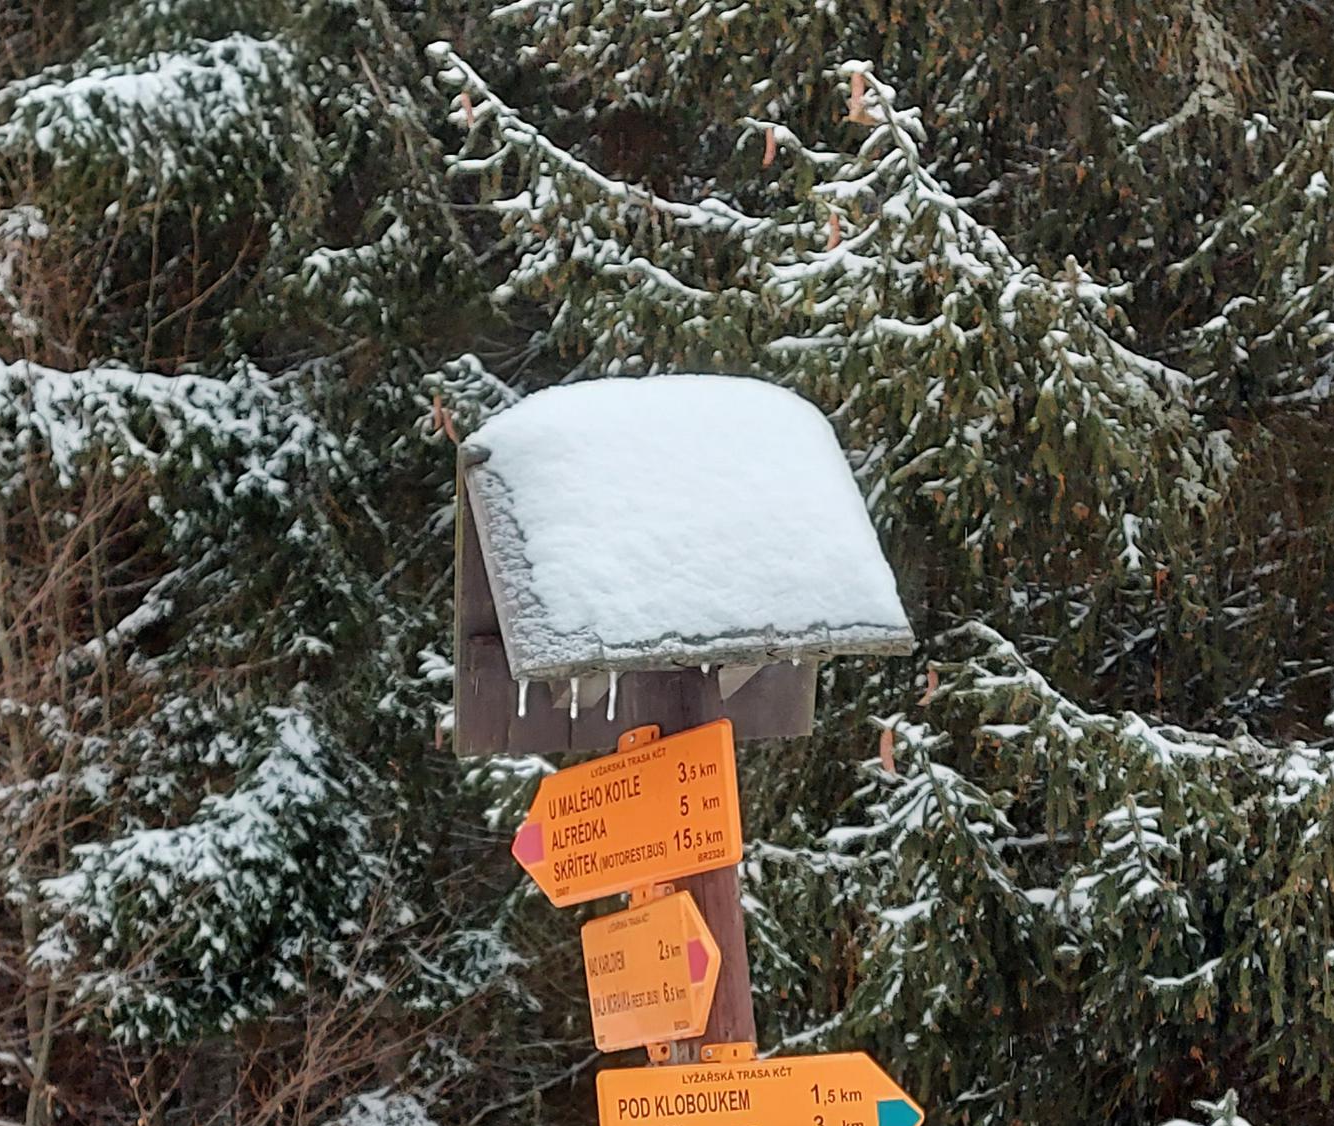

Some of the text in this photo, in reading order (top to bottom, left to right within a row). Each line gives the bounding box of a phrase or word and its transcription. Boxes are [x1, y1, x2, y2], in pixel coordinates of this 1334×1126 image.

[548, 775, 641, 820] U MALÉHO KOTLE
[551, 795, 720, 851] ALFRÉDKA 5 km
[553, 829, 723, 882] SKŘÍTEK km
[682, 1066, 792, 1085] LYŽAŘSKÁ TRASA KČT
[618, 1083, 862, 1120] POD KLOBOUKEM 1,5 km
